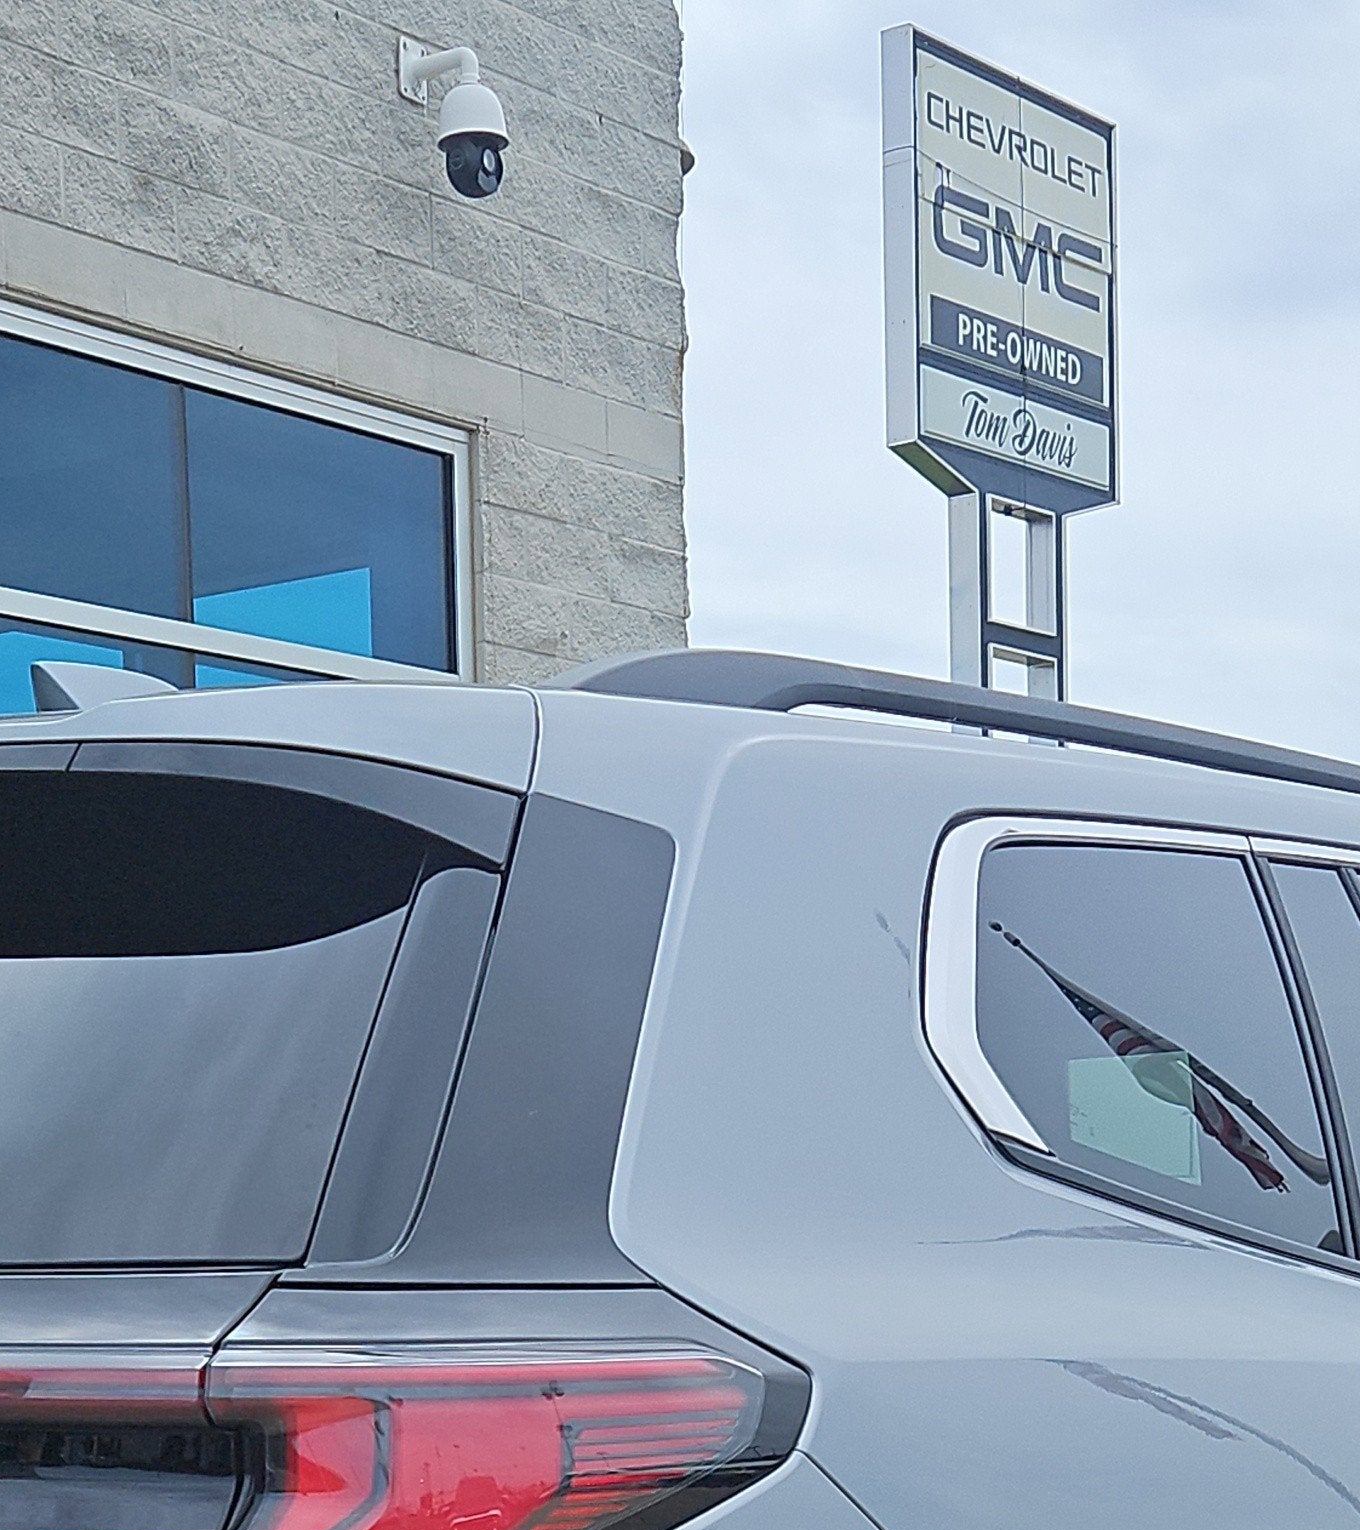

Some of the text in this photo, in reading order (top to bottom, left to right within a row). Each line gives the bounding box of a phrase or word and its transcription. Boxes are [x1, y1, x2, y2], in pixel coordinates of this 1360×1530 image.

[926, 91, 1103, 198] CHEVROLET
[933, 184, 1103, 313] GMC
[957, 312, 1082, 386] PRE-OWNED
[961, 390, 1078, 469] Tom Davis
